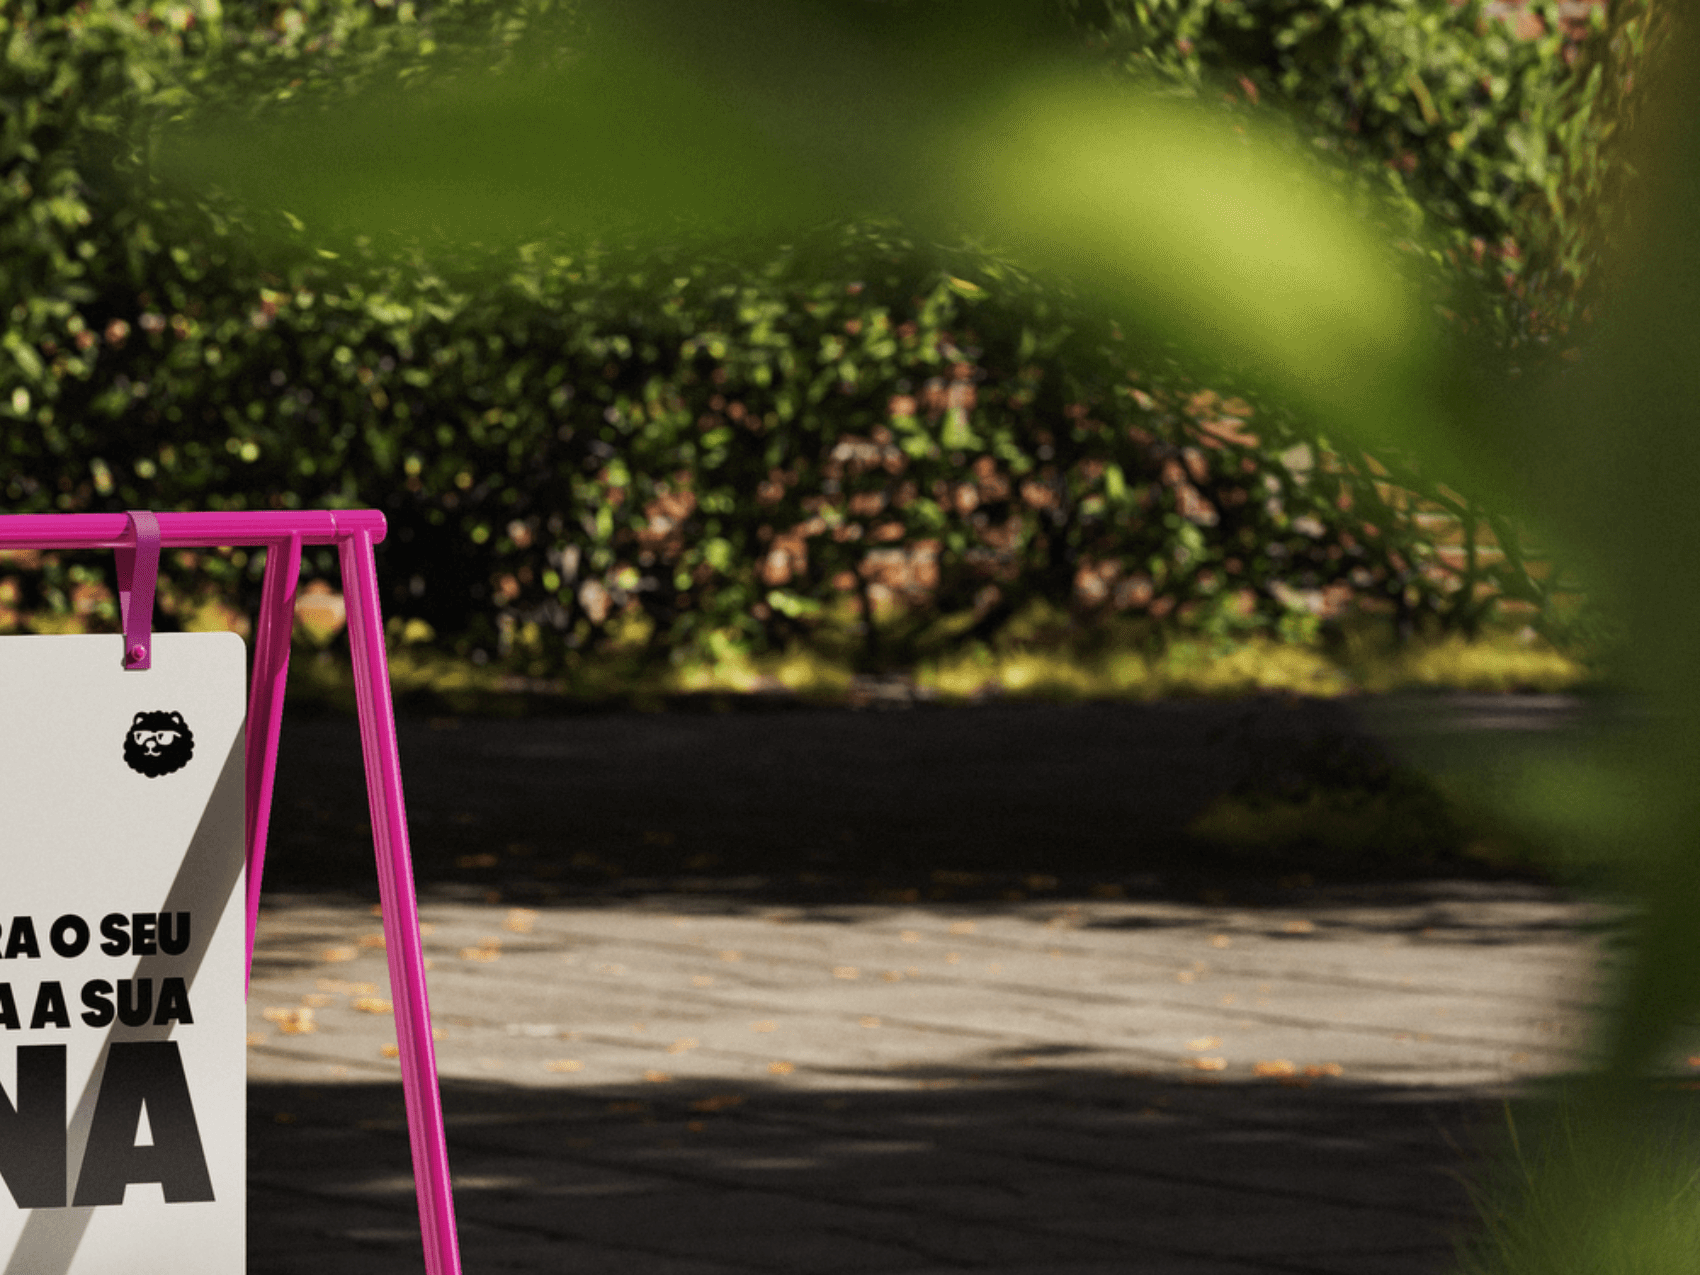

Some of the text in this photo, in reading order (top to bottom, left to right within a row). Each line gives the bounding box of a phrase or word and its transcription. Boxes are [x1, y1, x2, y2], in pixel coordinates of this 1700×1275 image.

[49, 914, 91, 958] O
[99, 911, 192, 957] SEU
[30, 981, 71, 1029] A
[81, 977, 195, 1028] SUA
